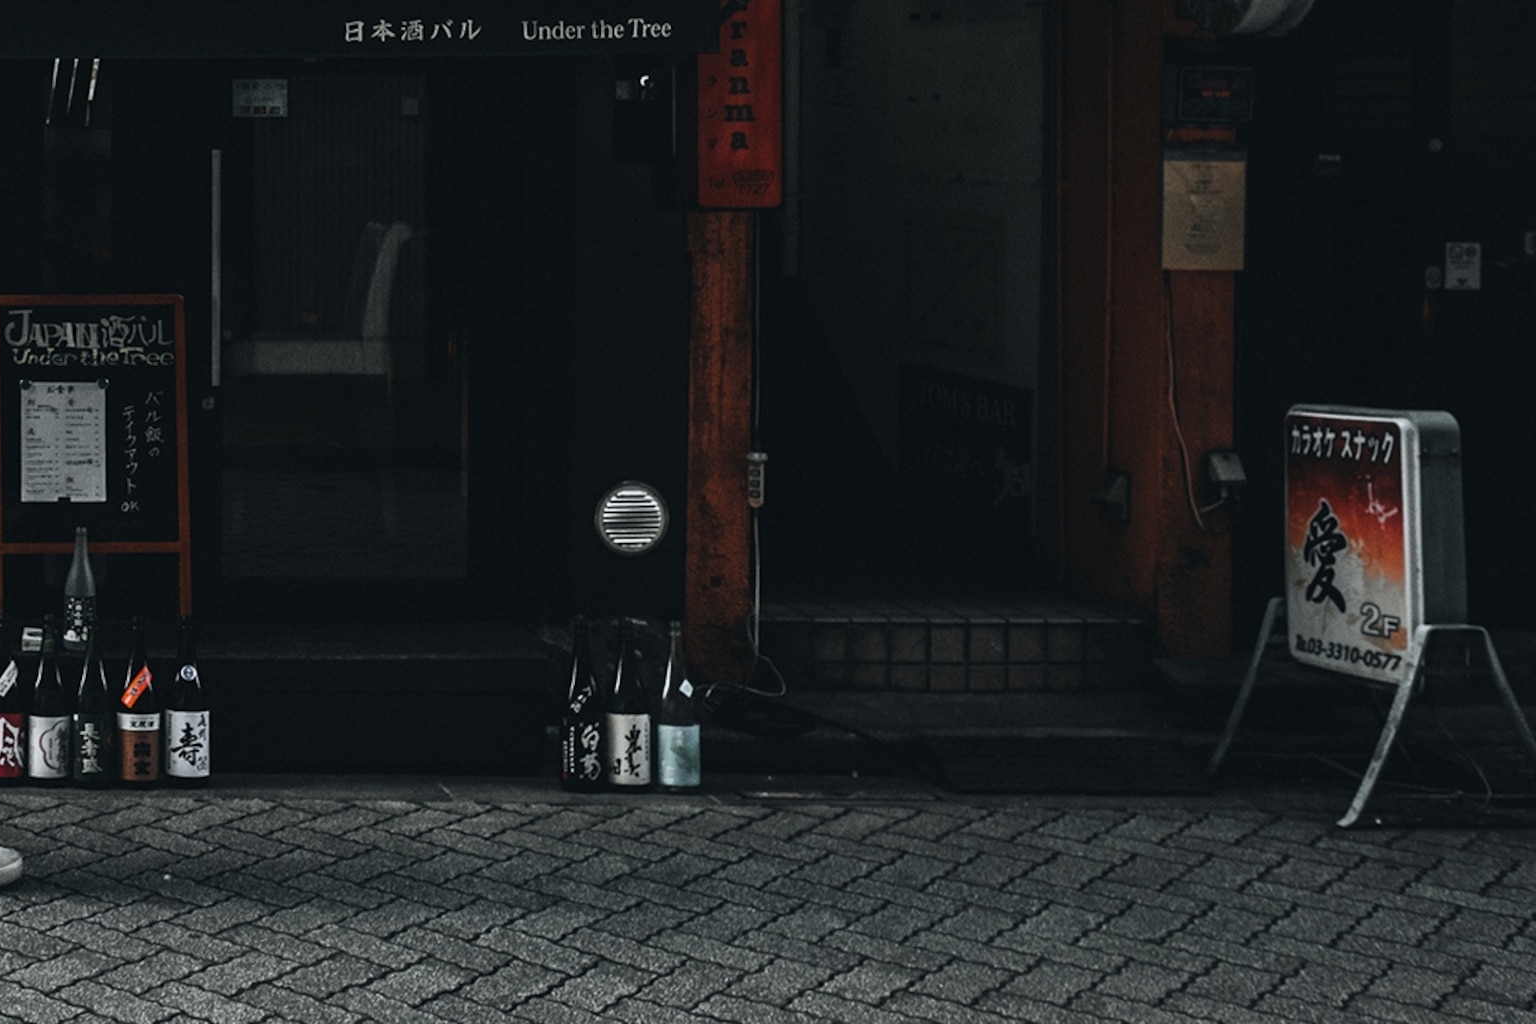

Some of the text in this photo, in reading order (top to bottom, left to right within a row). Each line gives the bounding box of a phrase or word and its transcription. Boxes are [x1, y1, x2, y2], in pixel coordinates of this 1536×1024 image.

[344, 17, 672, 42] 日本酒バル Under the Tree
[1291, 425, 1396, 465] カラオケ スナック
[1303, 497, 1349, 615] 愛
[1360, 602, 1401, 639] 2F
